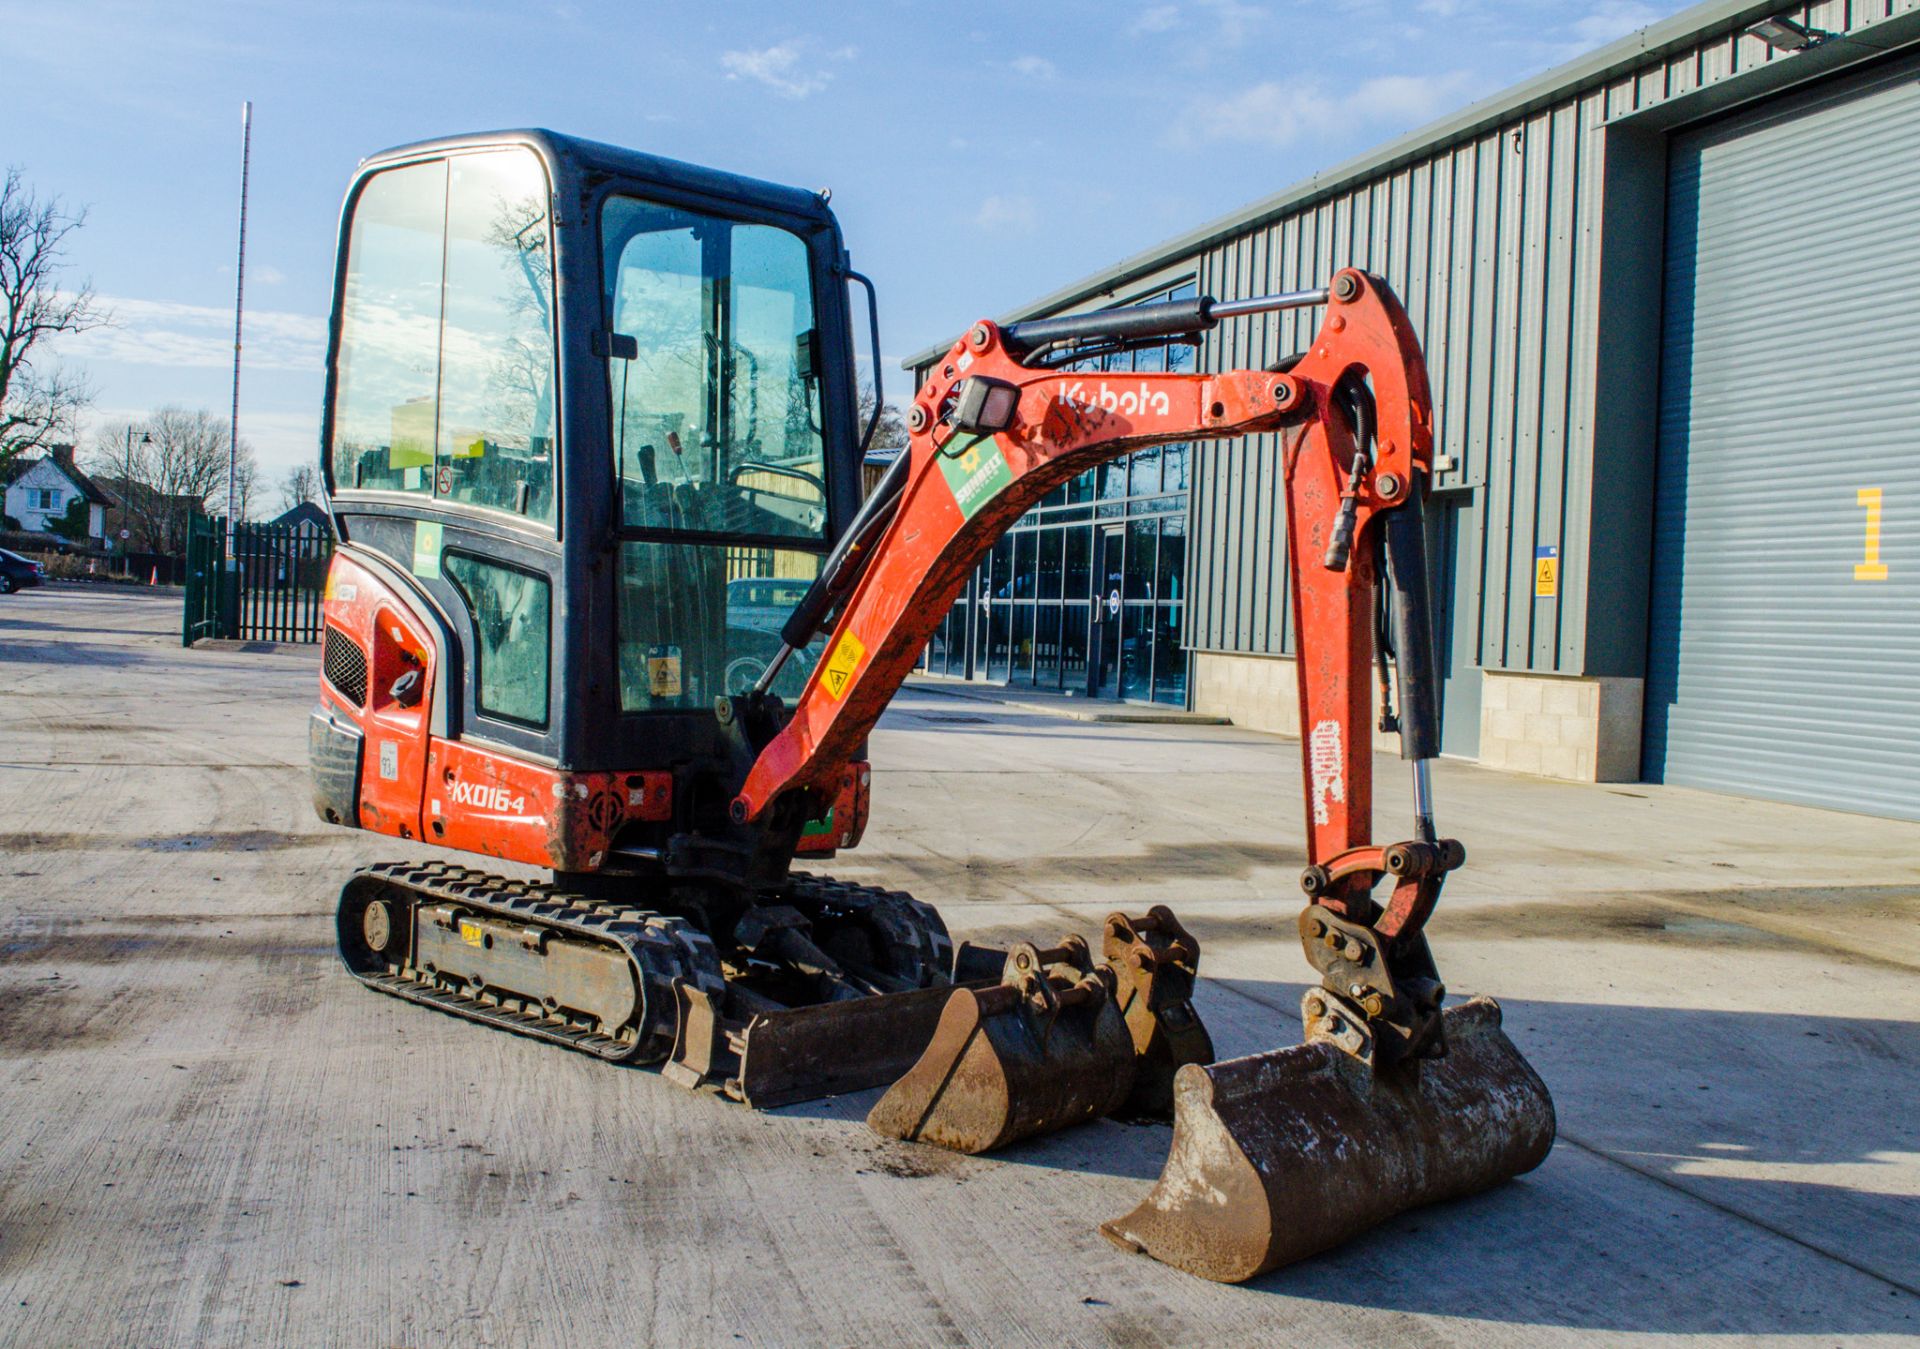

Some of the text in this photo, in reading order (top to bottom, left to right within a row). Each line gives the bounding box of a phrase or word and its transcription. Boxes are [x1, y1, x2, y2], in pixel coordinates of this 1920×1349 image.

[1058, 381, 1169, 416] Kubota
[956, 452, 1002, 504] SUNBELT
[1854, 487, 1889, 581] 1
